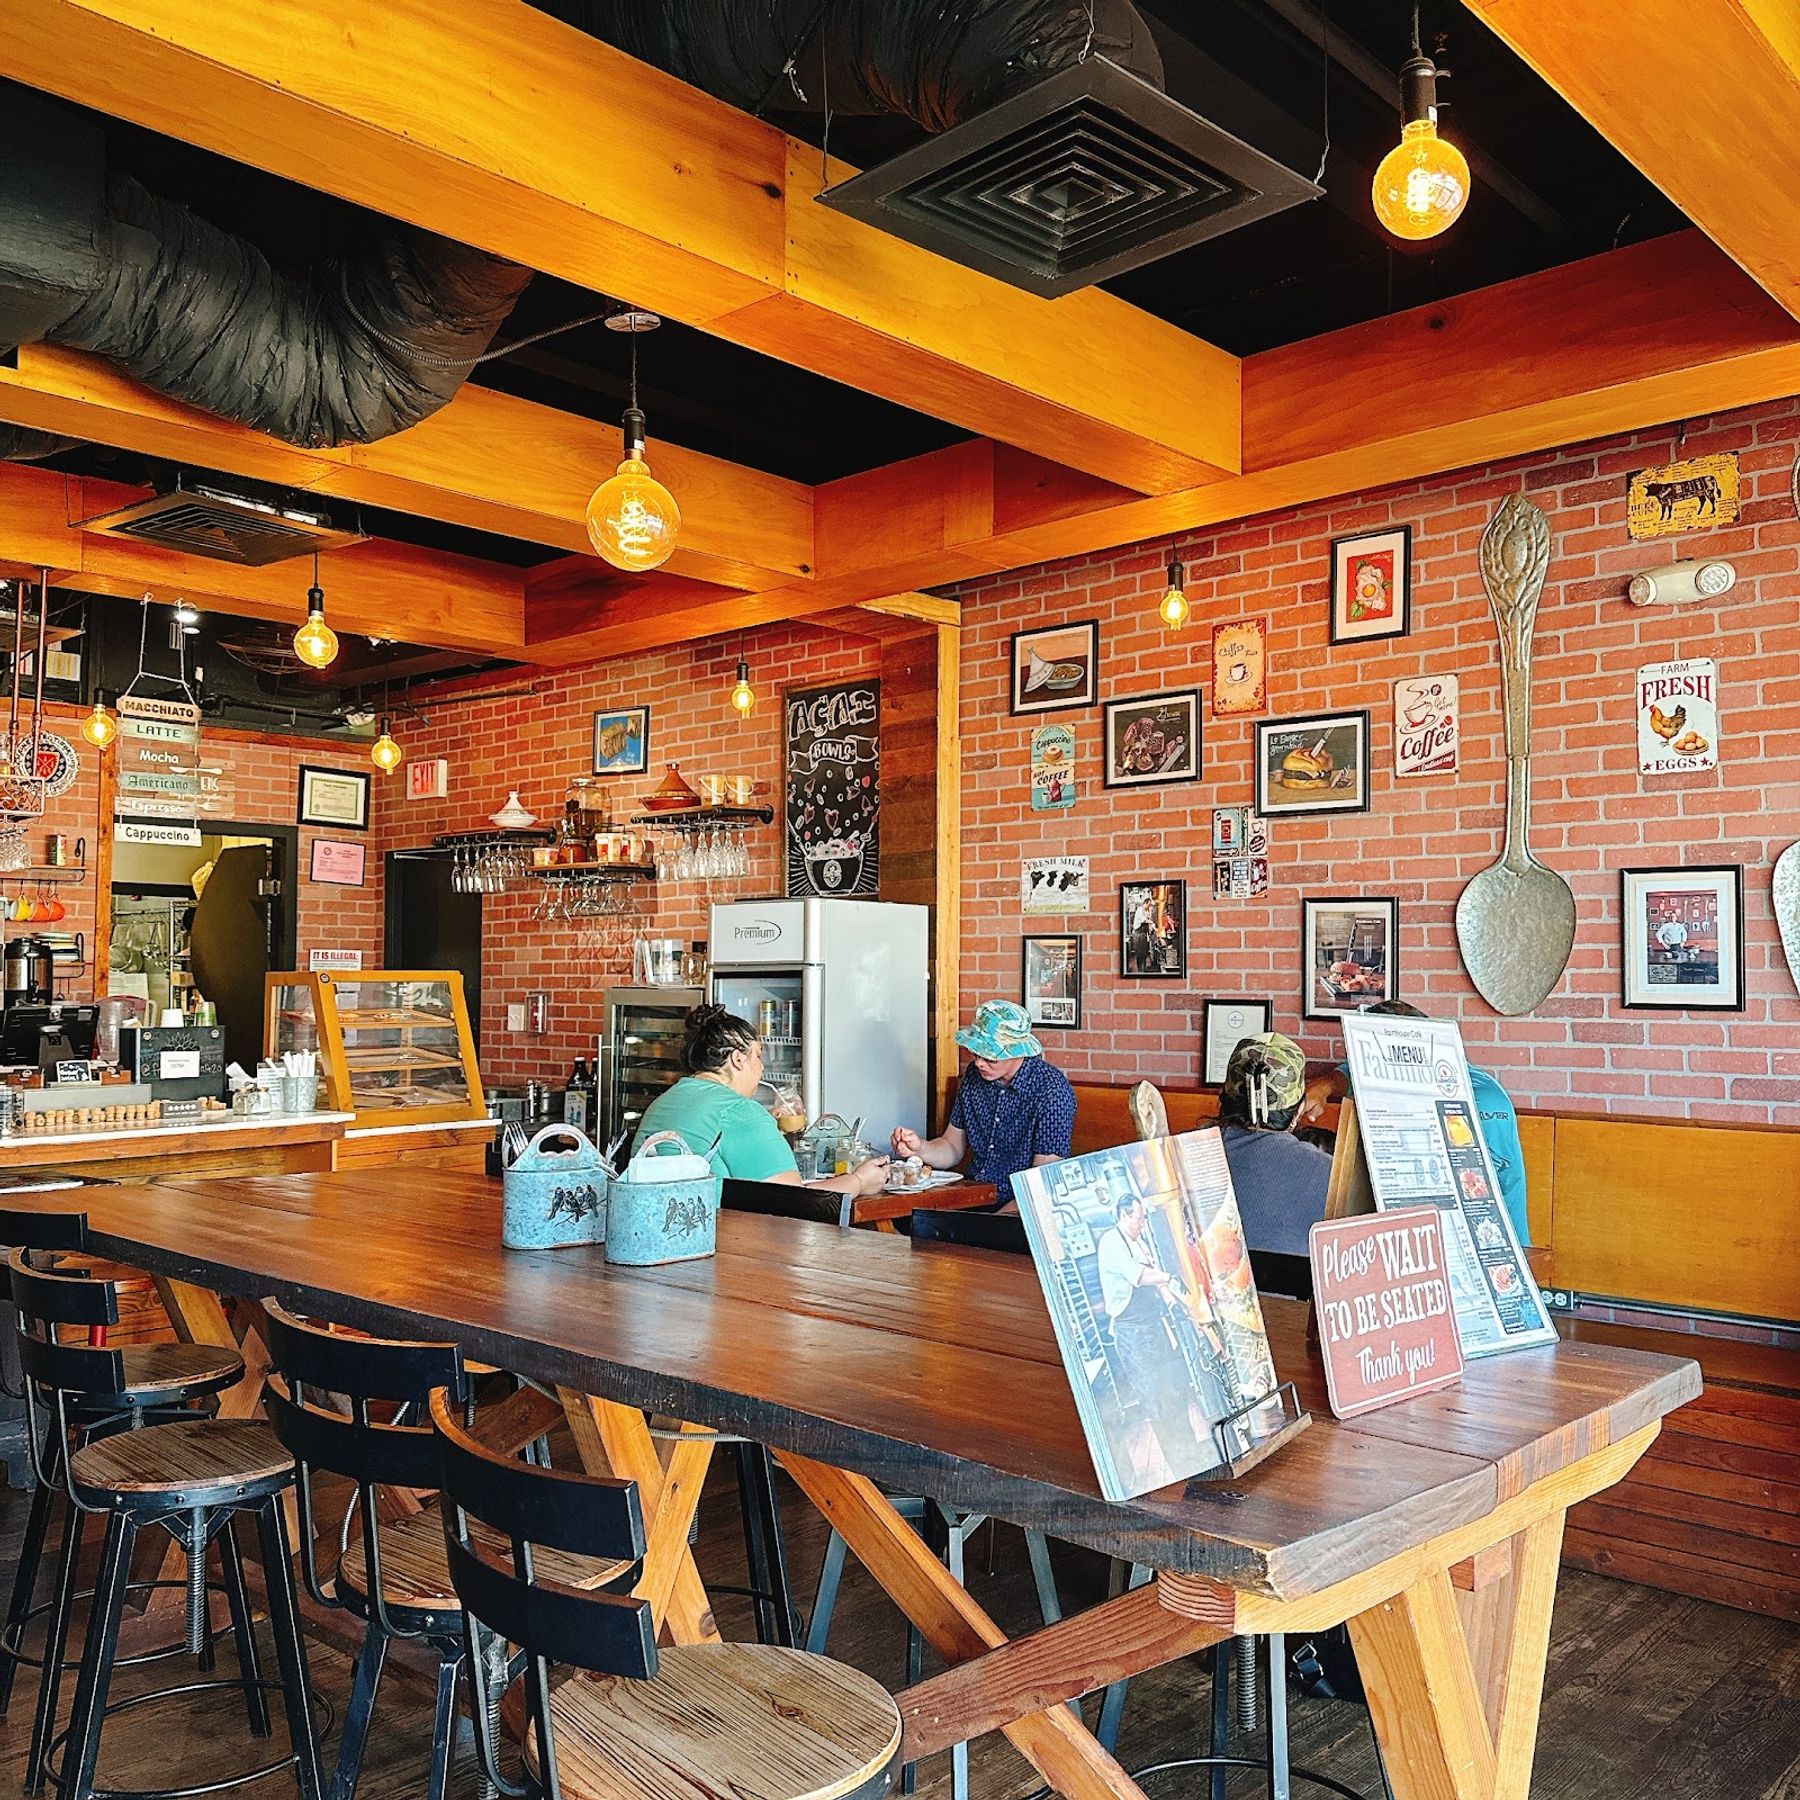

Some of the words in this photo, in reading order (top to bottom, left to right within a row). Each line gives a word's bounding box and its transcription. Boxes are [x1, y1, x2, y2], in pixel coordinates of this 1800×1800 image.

[1660, 663, 1690, 675] FARM
[1641, 674, 1712, 710] FRESH
[125, 700, 194, 719] MACCHIATO
[136, 724, 182, 739] LATTE
[812, 742, 853, 761] BOWLS
[1400, 726, 1455, 761] Coffee
[139, 749, 179, 764] Mocha
[1655, 757, 1697, 771] EGGS
[127, 775, 189, 791] Americano
[412, 761, 436, 796] EXIT
[1037, 769, 1069, 786] COFFEE
[125, 826, 190, 842] Cappuccino
[1027, 858, 1057, 871] FRESH
[1060, 858, 1083, 869] MILK
[734, 926, 775, 939] Premium
[313, 951, 321, 960] IT
[321, 951, 330, 960] IS
[1322, 1235, 1377, 1289] Please
[1375, 1224, 1437, 1281] WAIT
[1325, 1302, 1352, 1342] TO
[1353, 1293, 1381, 1335] BE
[1380, 1279, 1446, 1329] SEATED
[1356, 1340, 1403, 1385] Thank
